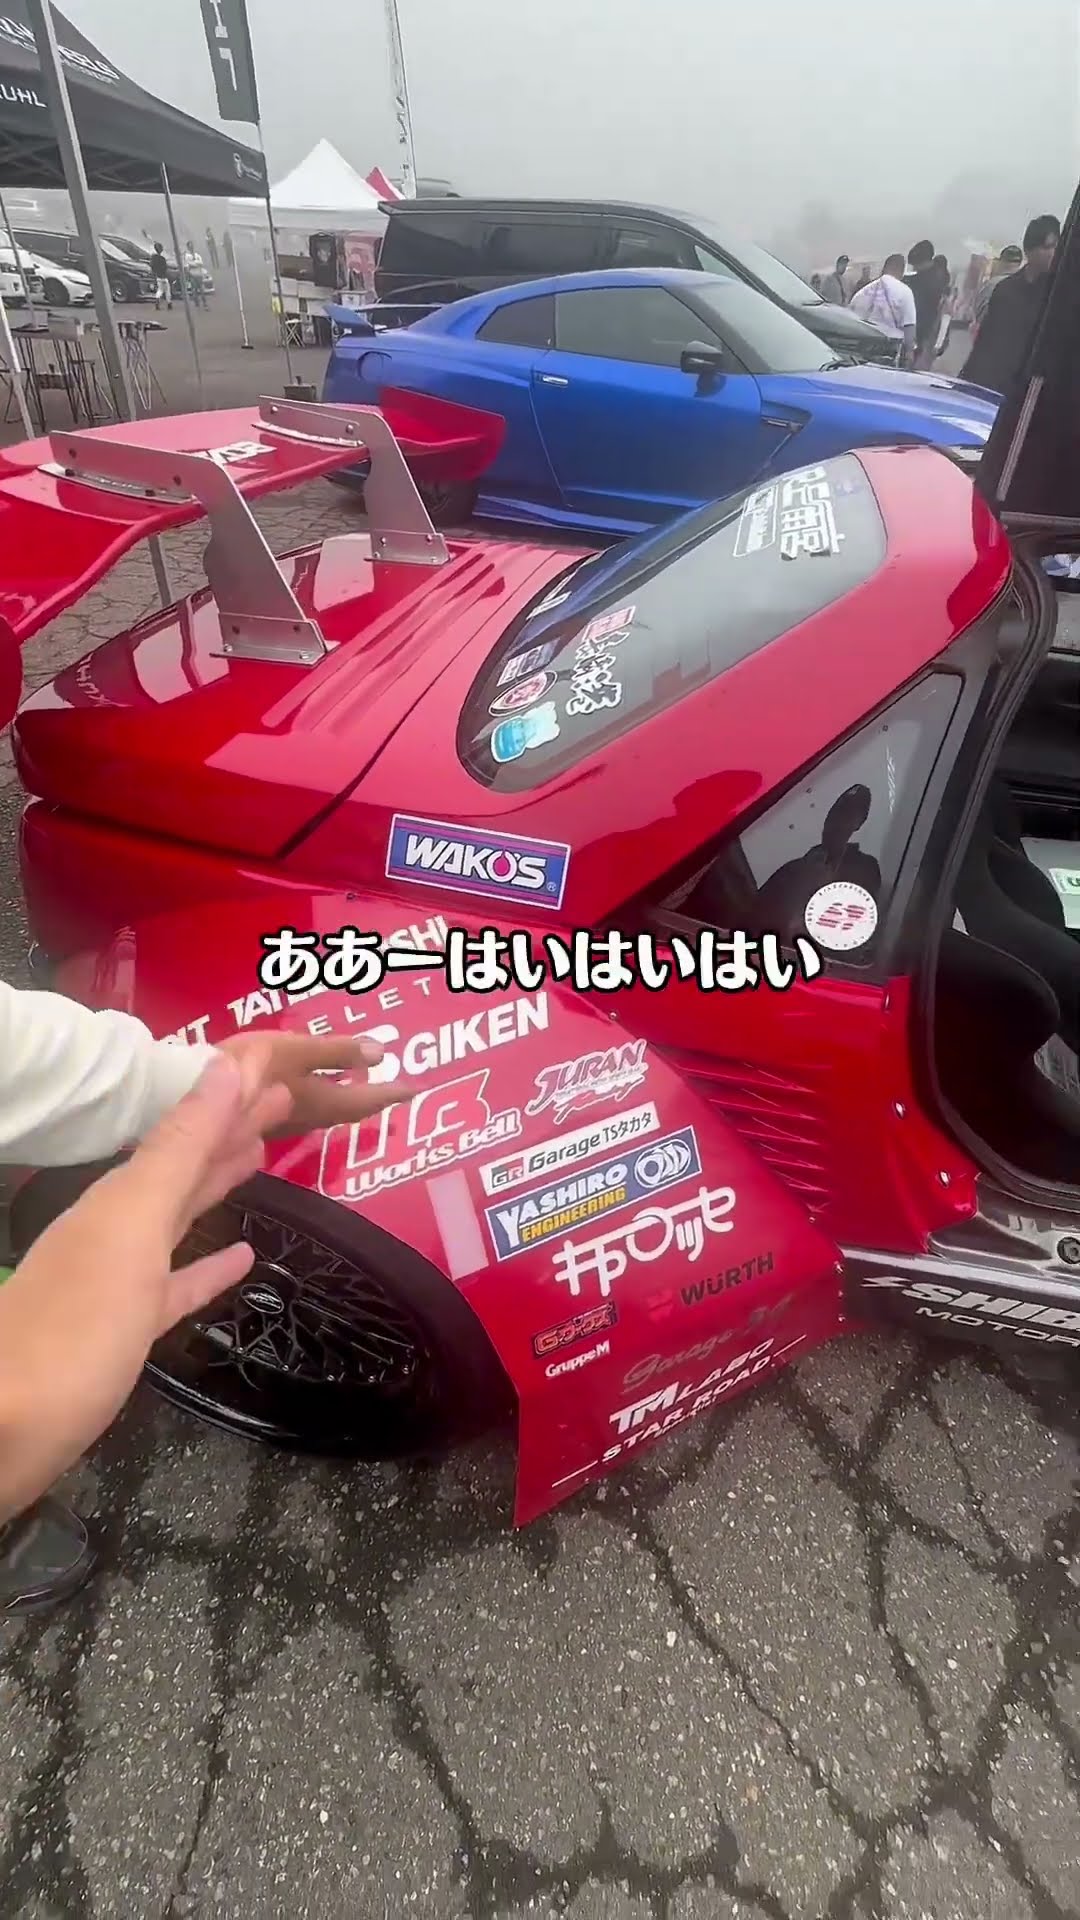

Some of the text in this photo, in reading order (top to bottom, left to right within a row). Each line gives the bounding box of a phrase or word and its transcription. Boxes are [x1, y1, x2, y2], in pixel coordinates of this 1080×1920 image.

[528, 1134, 601, 1172] Garage
[497, 1164, 628, 1248] YASHIRO
[520, 1187, 627, 1242] ENGINEERING
[602, 1407, 684, 1462] STAR
